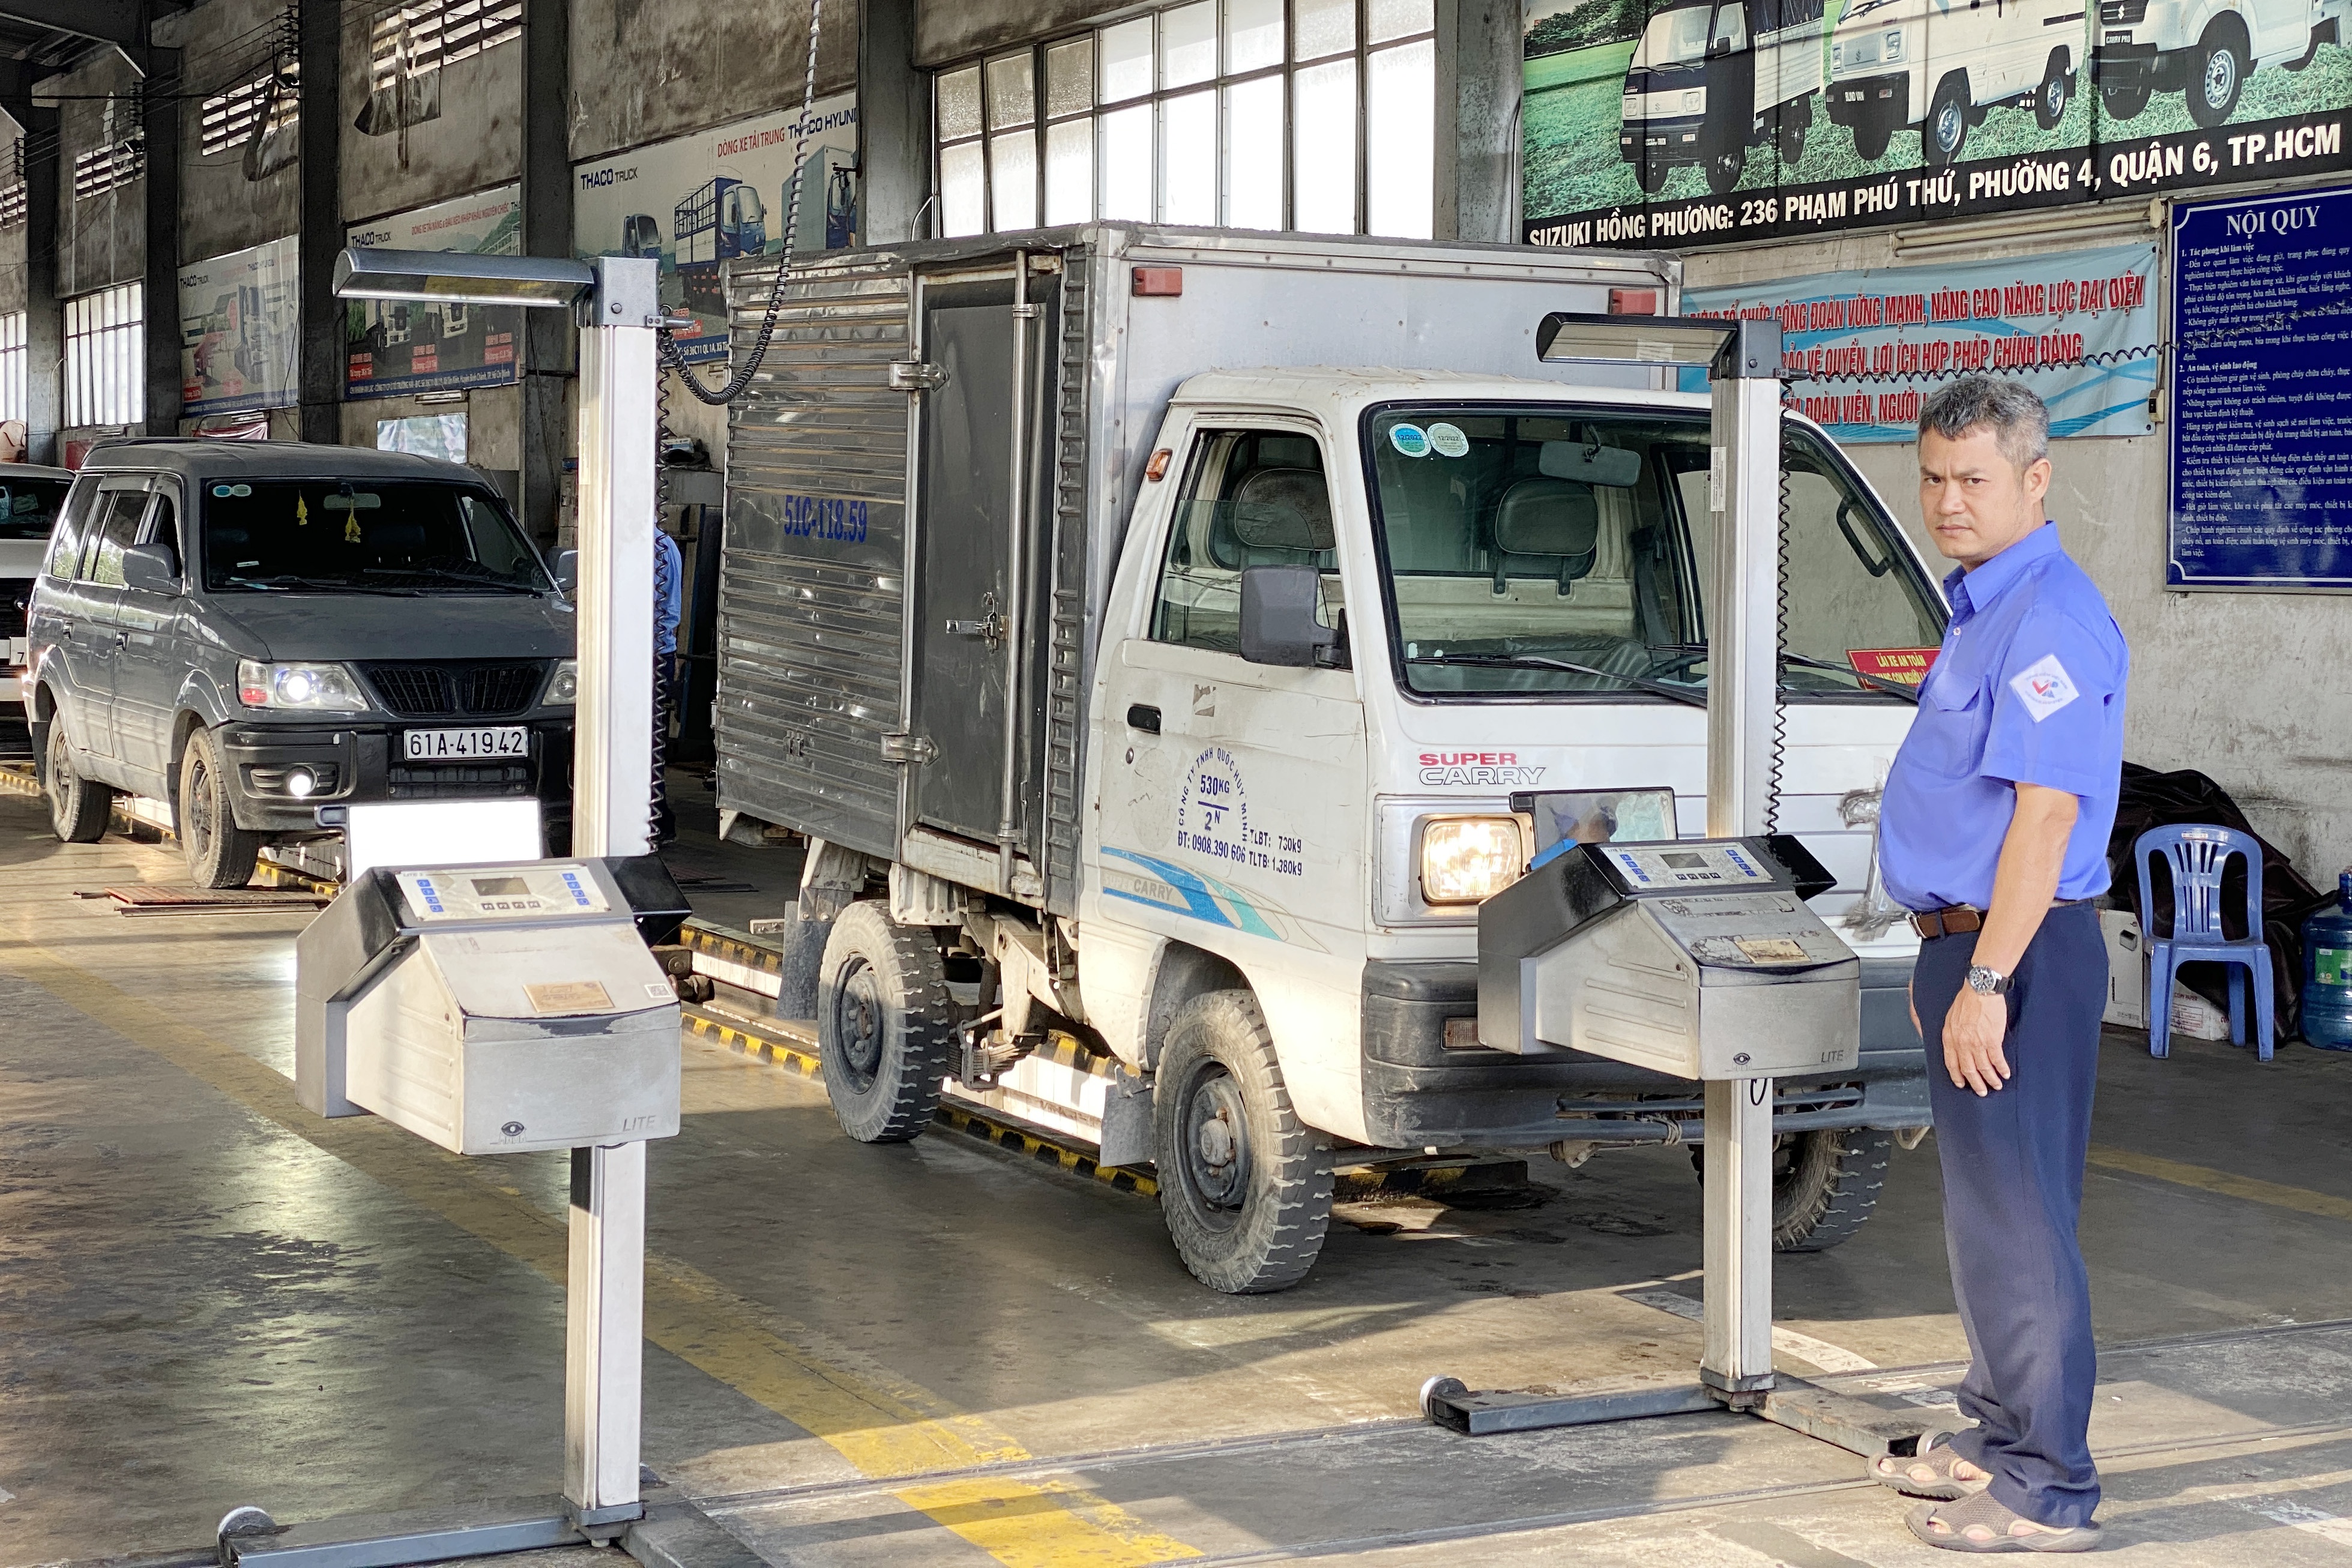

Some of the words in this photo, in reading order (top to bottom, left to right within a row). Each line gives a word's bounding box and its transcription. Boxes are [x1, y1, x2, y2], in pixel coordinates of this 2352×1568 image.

[717, 136, 738, 158] DÒNG
[738, 138, 748, 152] XE
[748, 129, 761, 151] TẢI
[761, 127, 785, 148] TRUNG
[580, 169, 614, 190] THACO
[615, 166, 638, 184] TRUCK
[1530, 223, 1590, 247] SUZUKI
[1596, 206, 1645, 242] HỒNG
[1651, 205, 1733, 237] PHƯƠNG:
[1741, 199, 1778, 226] 236
[1785, 191, 1846, 225] PHẠM
[1854, 176, 1898, 214] PHÚ
[1906, 169, 1961, 207] THỨ,
[1970, 159, 2069, 199] PHƯỜNG
[2077, 158, 2101, 191] 4,
[2110, 141, 2184, 188] QUẬN
[2192, 141, 2219, 176] 6,
[2228, 123, 2341, 166] TP.HCM
[2227, 210, 2266, 239] NỘI
[2272, 206, 2320, 235] QUY
[351, 231, 374, 248] THACO
[375, 232, 391, 244] TRUCK
[1810, 295, 1845, 332] ĐOÀN
[1847, 293, 1882, 328] VỮNG
[1884, 294, 1928, 331] MẠNH,
[1931, 286, 1969, 322] NÂNG
[1973, 288, 2000, 319] CAO
[2003, 280, 2045, 317] NĂNG
[2049, 279, 2077, 320] LỰC
[2079, 279, 2106, 318] ĐẠI
[2109, 270, 2146, 316] DIỆN
[1807, 344, 1824, 382] VỆ
[1896, 339, 1918, 372] ÍCH
[1923, 339, 1950, 377] HỢP
[1953, 333, 1991, 370] PHÁP
[1994, 330, 2037, 367] CHÍNH
[2040, 328, 2084, 366] ĐÁNG
[1805, 390, 1841, 425] ĐOÀN
[1843, 390, 1876, 426] VIÊN,
[1878, 386, 1920, 423] NGƯỜI
[784, 495, 867, 543] 51C-118.59
[17, 652, 25, 663] 7
[1887, 655, 1899, 667] XE
[1898, 655, 1909, 667] AN
[411, 731, 523, 756] 61A-419.42
[1419, 753, 1518, 766] SUPER
[1178, 786, 1189, 826] CÔNG
[1187, 766, 1195, 783] TY
[1196, 747, 1213, 768] TNHH
[1234, 769, 1244, 796] HUY
[1419, 767, 1546, 786] CARRY
[1178, 830, 1190, 849] ĐT:
[1192, 834, 1229, 858] 0908.390
[1231, 844, 1246, 863] 606
[1250, 829, 1271, 848] TLBT:
[1279, 836, 1301, 853] 730kg
[1249, 851, 1270, 868] TLTB:
[1272, 857, 1302, 876] 1.380kg
[1134, 878, 1174, 901] CARRY
[1821, 1050, 1844, 1063] LITE
[622, 1115, 657, 1132] LITE
